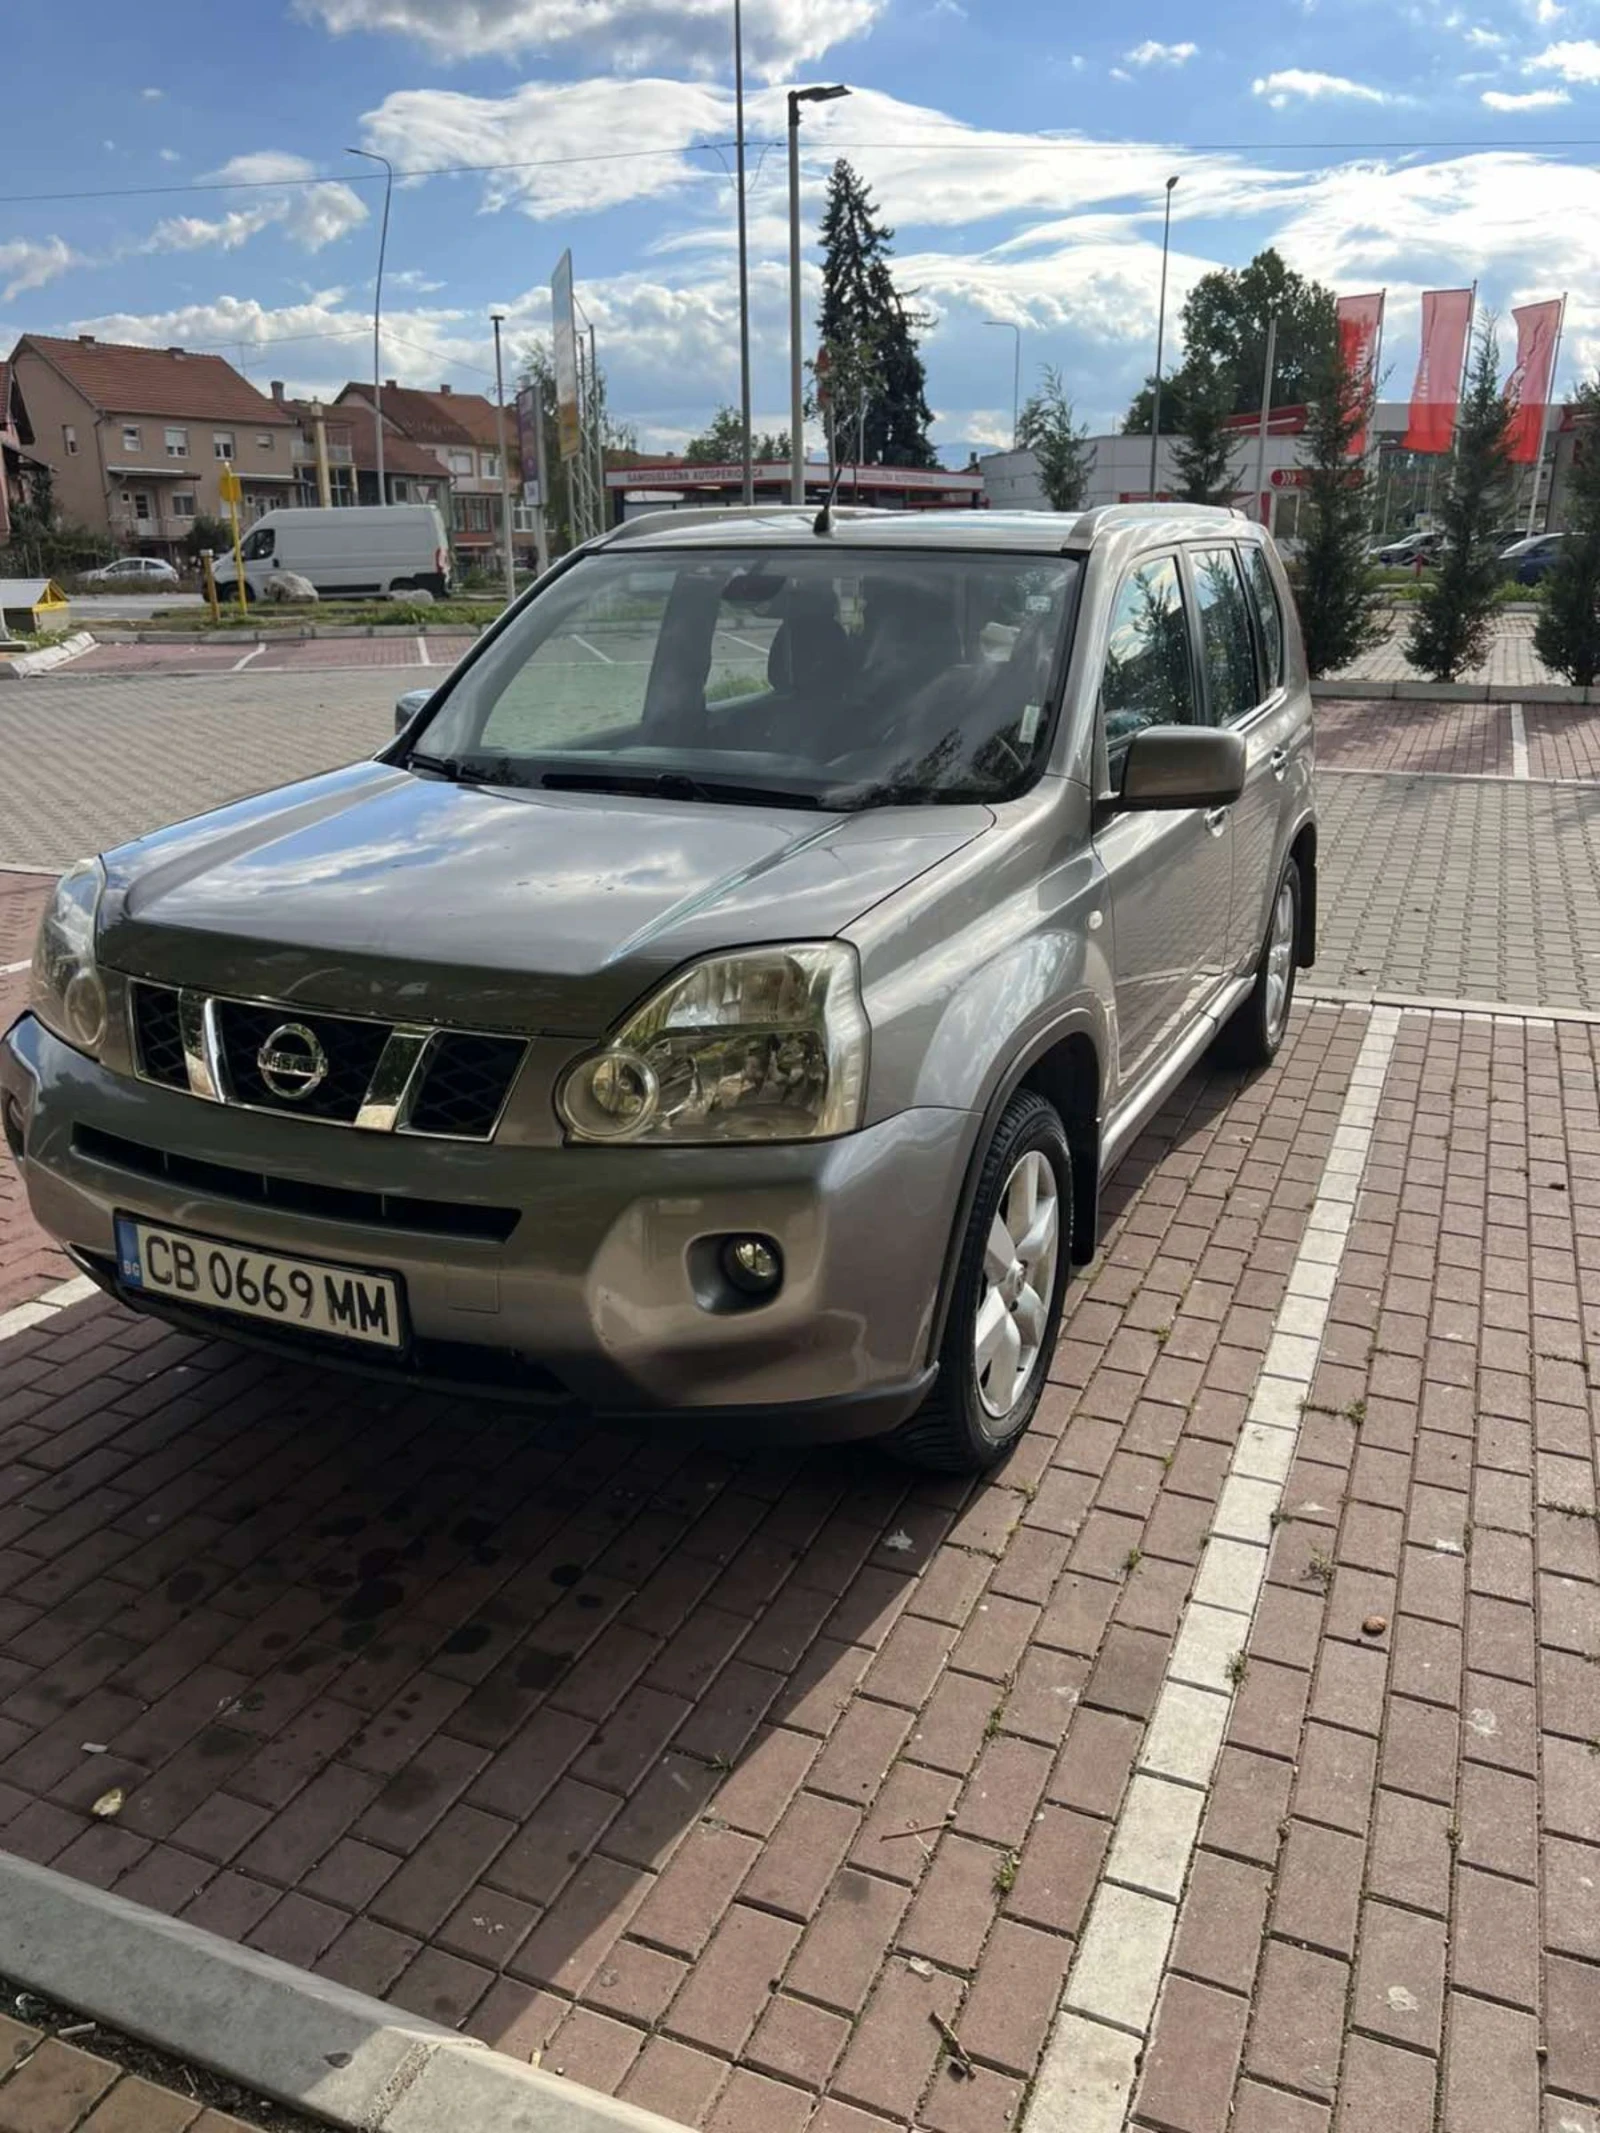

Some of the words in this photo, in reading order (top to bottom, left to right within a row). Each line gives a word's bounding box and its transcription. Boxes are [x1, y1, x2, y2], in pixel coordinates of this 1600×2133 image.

[259, 1050, 319, 1074] NISSAN
[123, 1260, 141, 1277] BG
[146, 1235, 200, 1292] CB
[208, 1251, 314, 1319] 0669
[324, 1274, 390, 1338] MM
